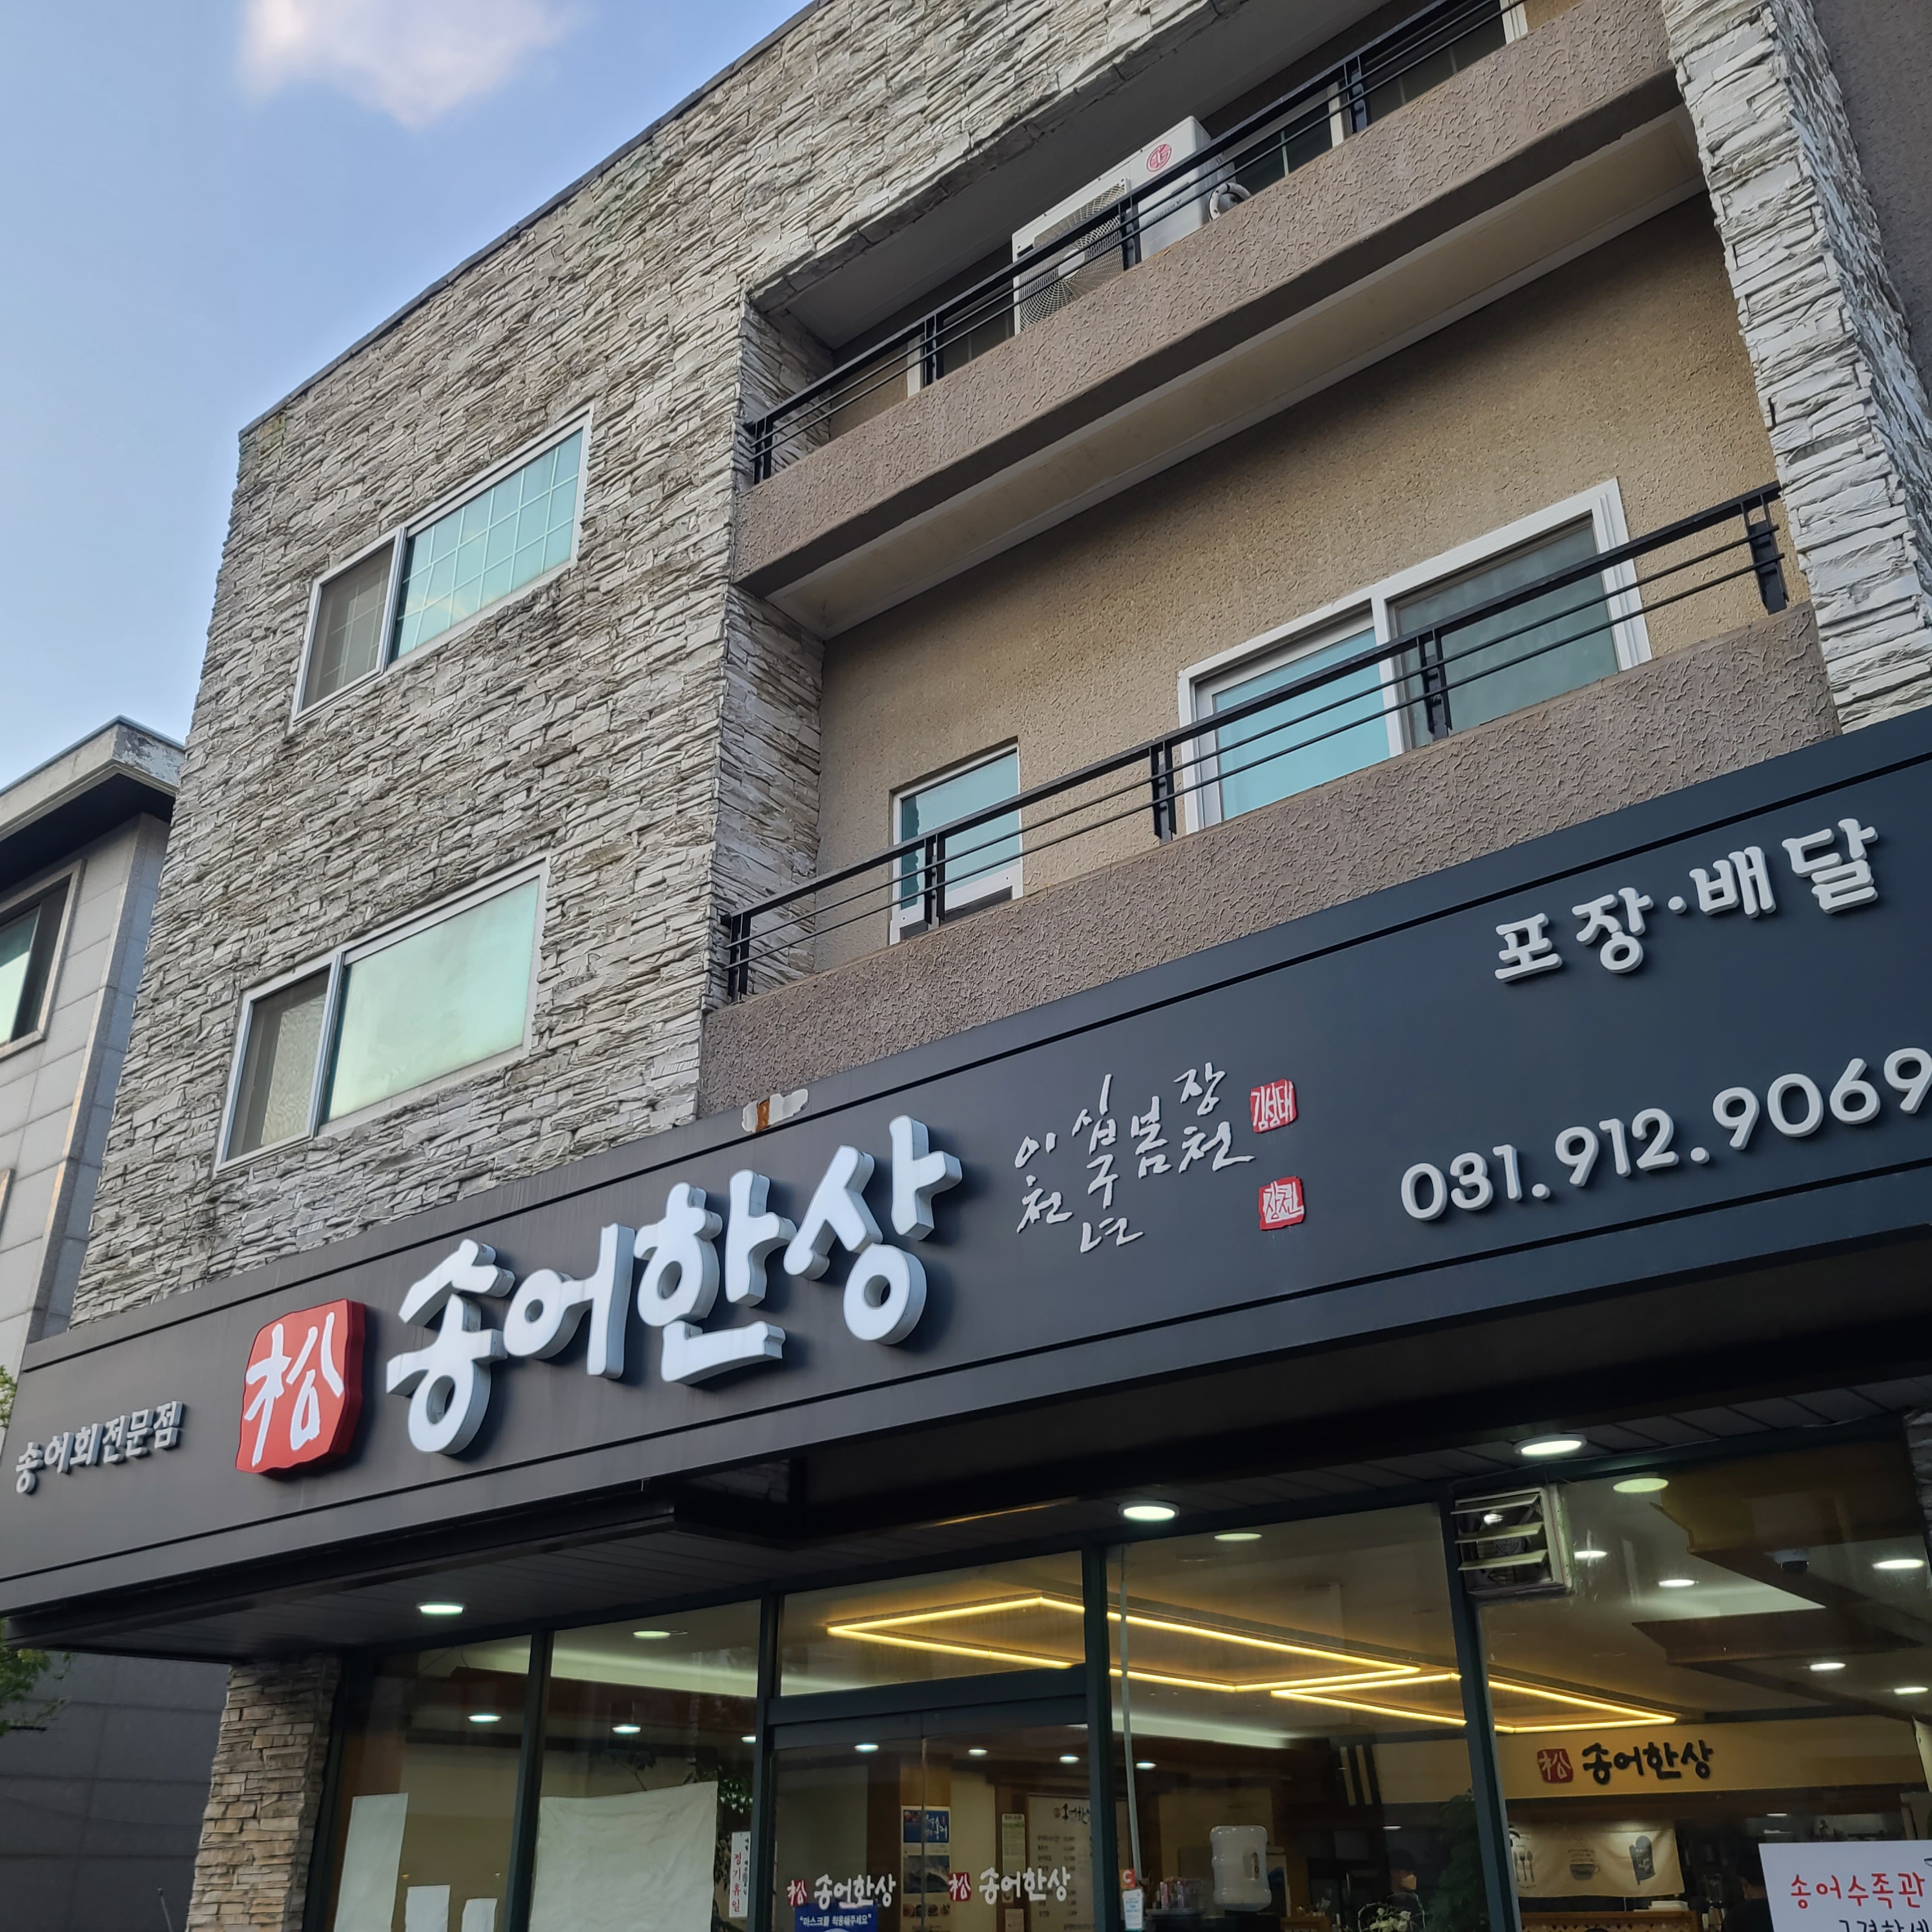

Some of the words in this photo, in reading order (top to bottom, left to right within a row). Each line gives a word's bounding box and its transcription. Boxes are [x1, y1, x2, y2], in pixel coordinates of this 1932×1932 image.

[1401, 1047, 1932, 1222] 031.912.9069
[386, 1115, 962, 1455] 송어한상
[1582, 1740, 1713, 1785] 송어한상
[732, 1852, 741, 1912] 정기휴일
[814, 1873, 896, 1910] 송어한상
[979, 1866, 1071, 1904] 송어한상
